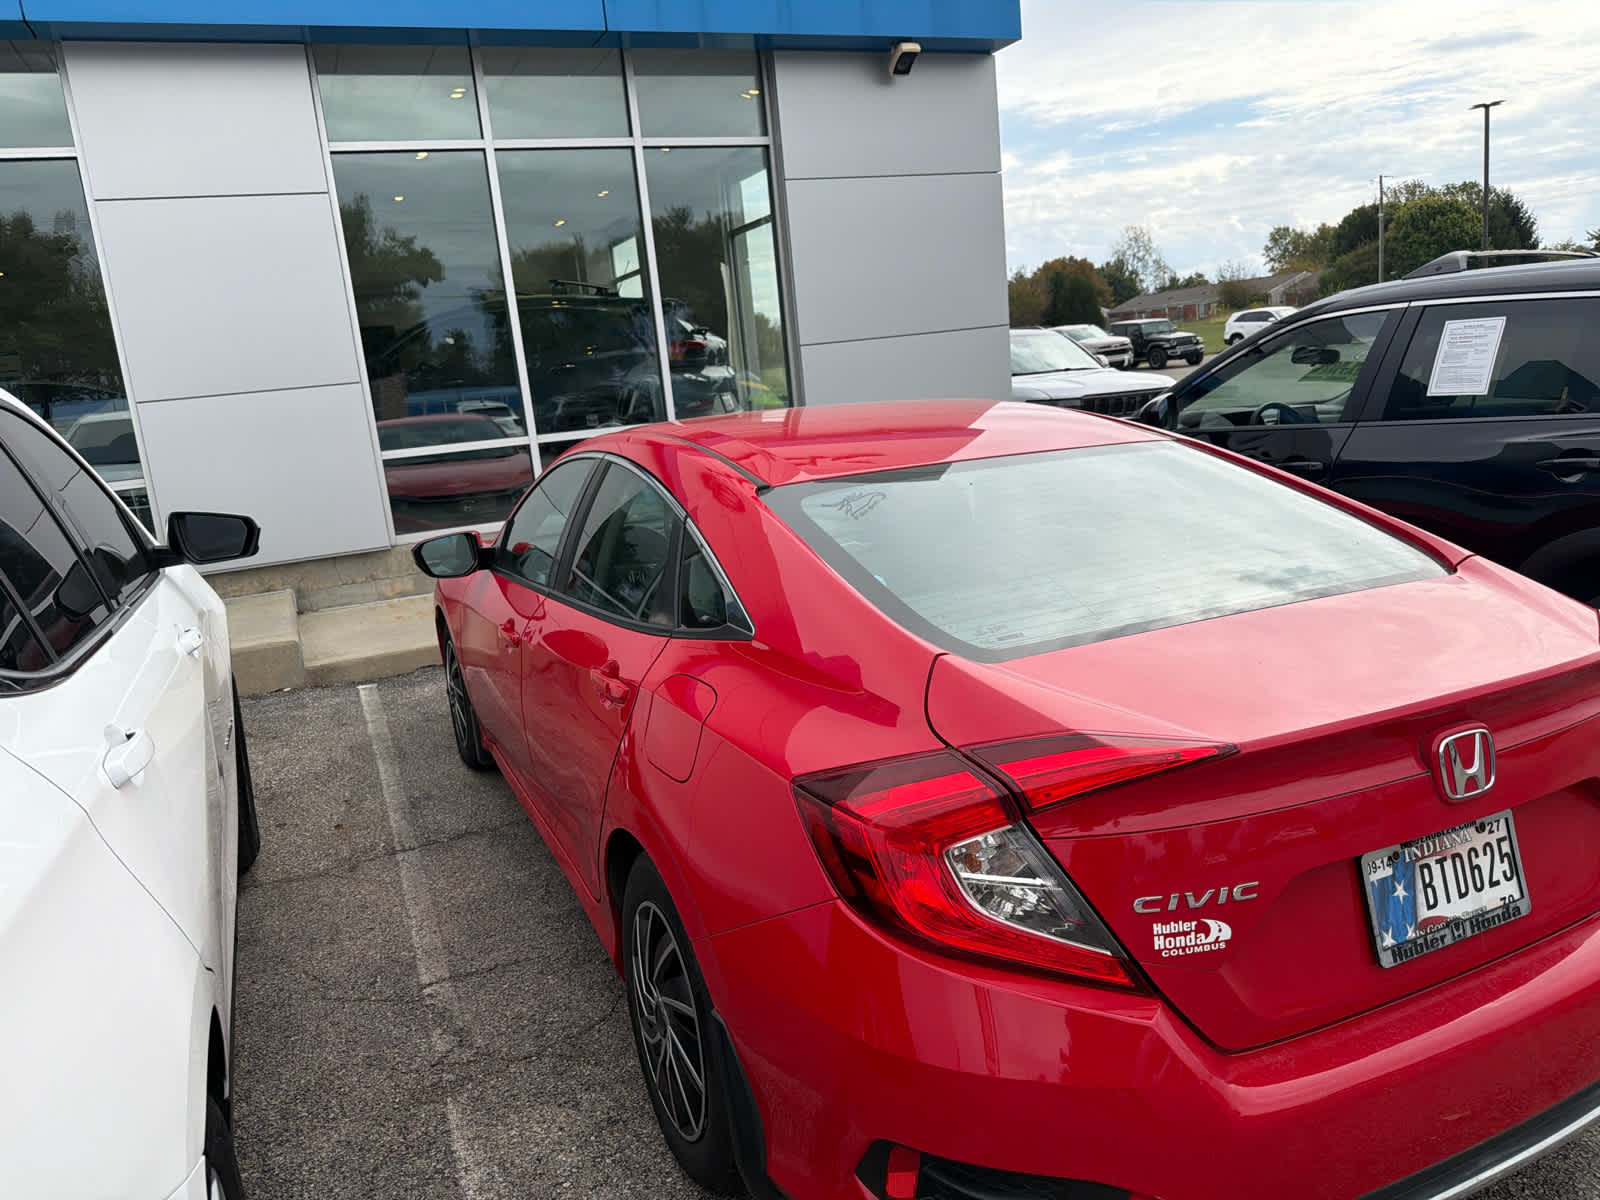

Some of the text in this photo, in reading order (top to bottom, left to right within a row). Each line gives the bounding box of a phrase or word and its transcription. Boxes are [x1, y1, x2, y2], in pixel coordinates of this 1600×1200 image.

[1487, 819, 1500, 835] 27
[1404, 829, 1472, 862] INDIANA
[1419, 836, 1515, 911] BTD625
[1133, 881, 1260, 914] CIVIC
[1153, 920, 1197, 935] Hubler
[1154, 931, 1206, 950] Honda
[1391, 933, 1447, 963] Hubler
[1470, 905, 1522, 934] Honda
[1161, 941, 1227, 958] COLUMBUS
